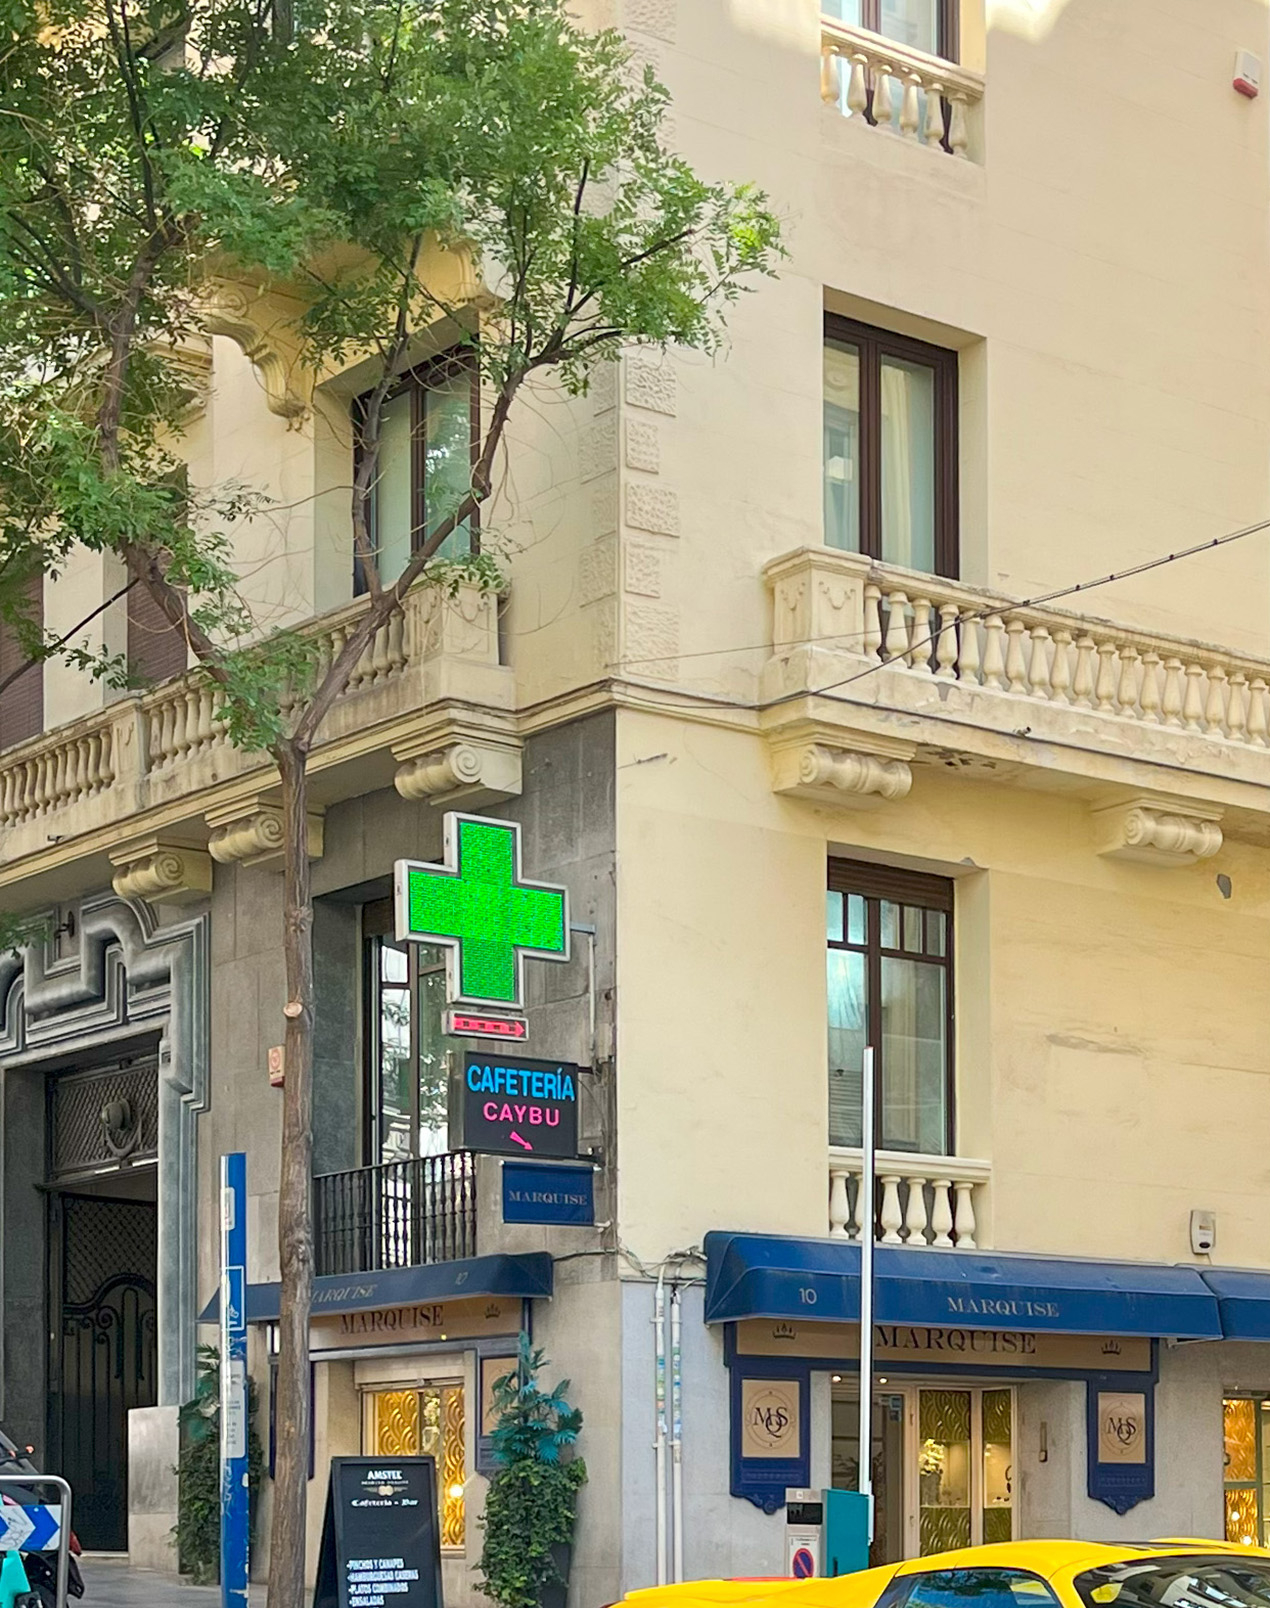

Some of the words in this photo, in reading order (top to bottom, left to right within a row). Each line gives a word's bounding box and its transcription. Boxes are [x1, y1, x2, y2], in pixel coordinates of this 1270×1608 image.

[467, 1065, 575, 1101] CAFETERÍA
[483, 1102, 560, 1126] CAYBU
[508, 1190, 588, 1206] MARQUISE
[799, 1287, 818, 1305] 10
[947, 1296, 1060, 1318] MARQUISE
[340, 1305, 444, 1335] MARQUISE
[875, 1325, 1037, 1354] MARQUISE
